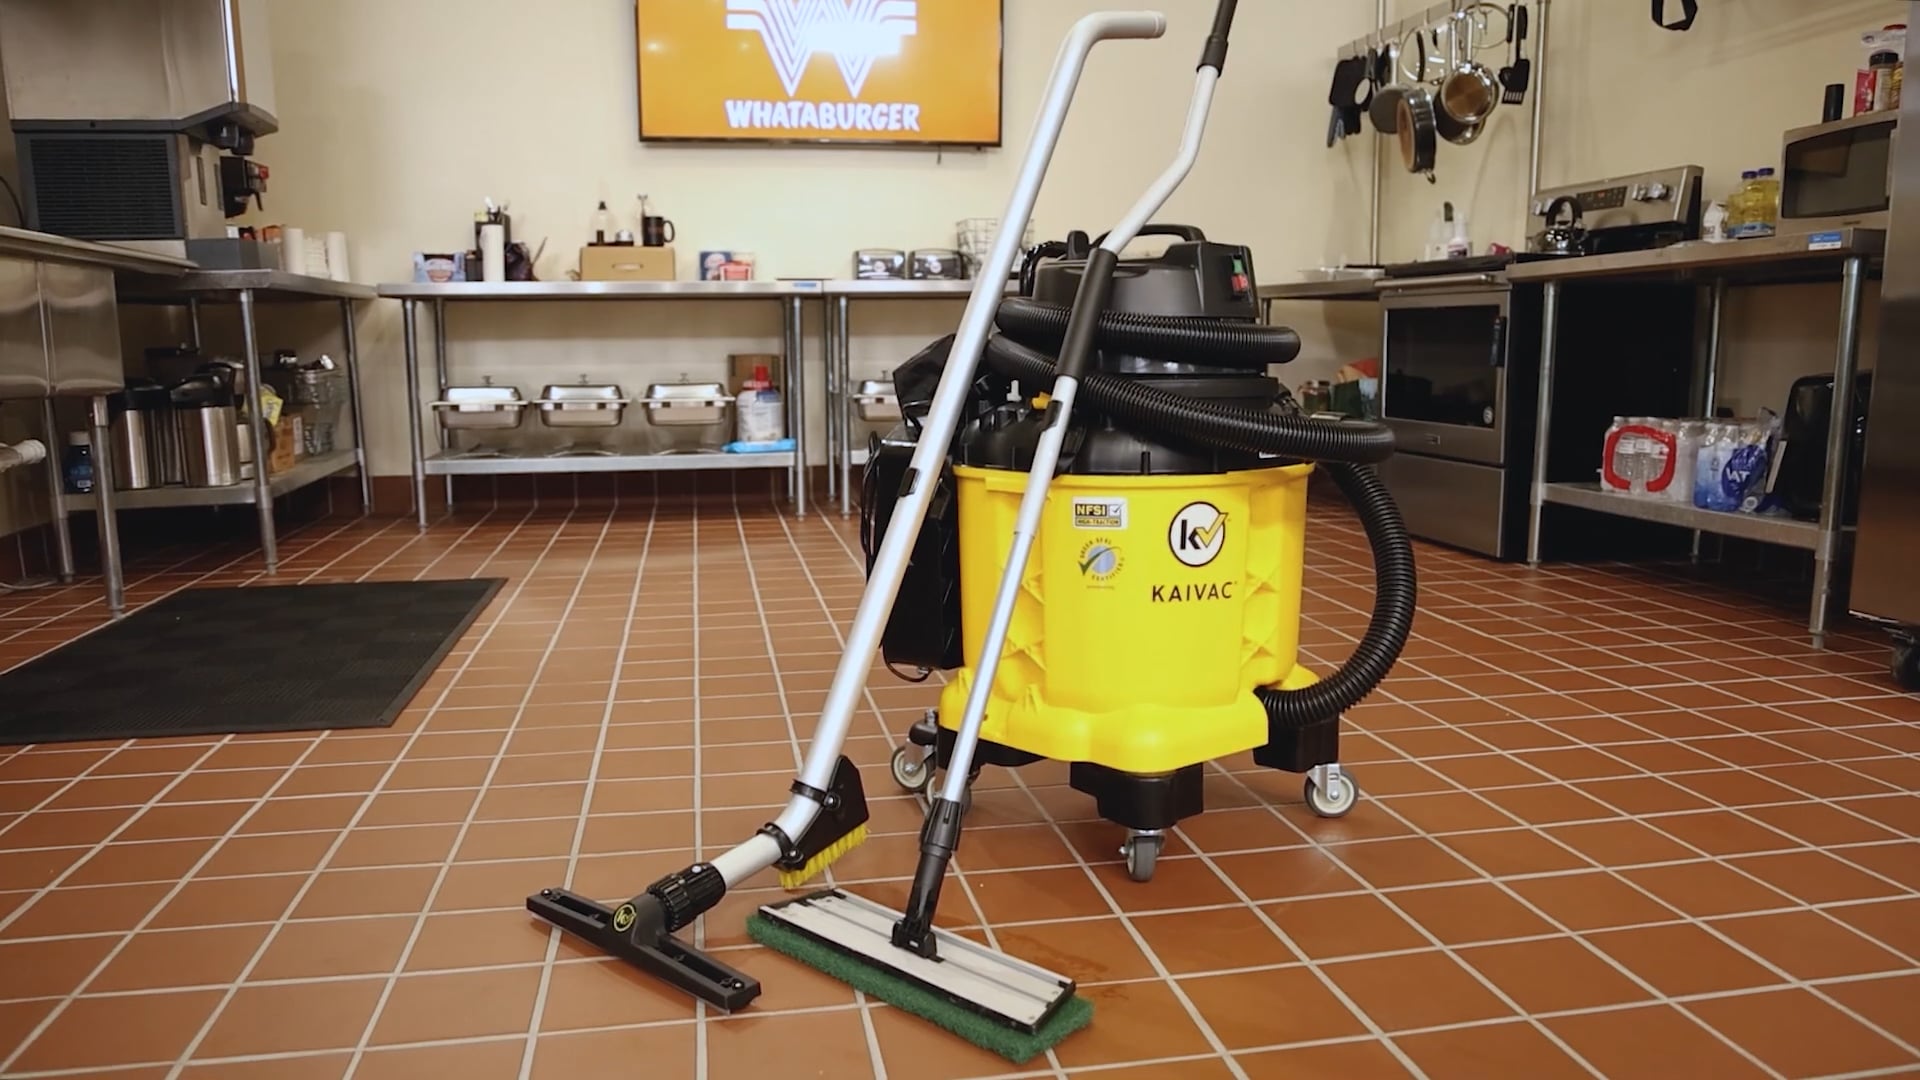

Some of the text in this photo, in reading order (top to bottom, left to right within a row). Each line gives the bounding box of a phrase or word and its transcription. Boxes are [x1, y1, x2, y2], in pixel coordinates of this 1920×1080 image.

[724, 100, 920, 131] WHATABURGER
[1076, 504, 1107, 516] NFSI
[1152, 581, 1233, 603] KAIVAC
